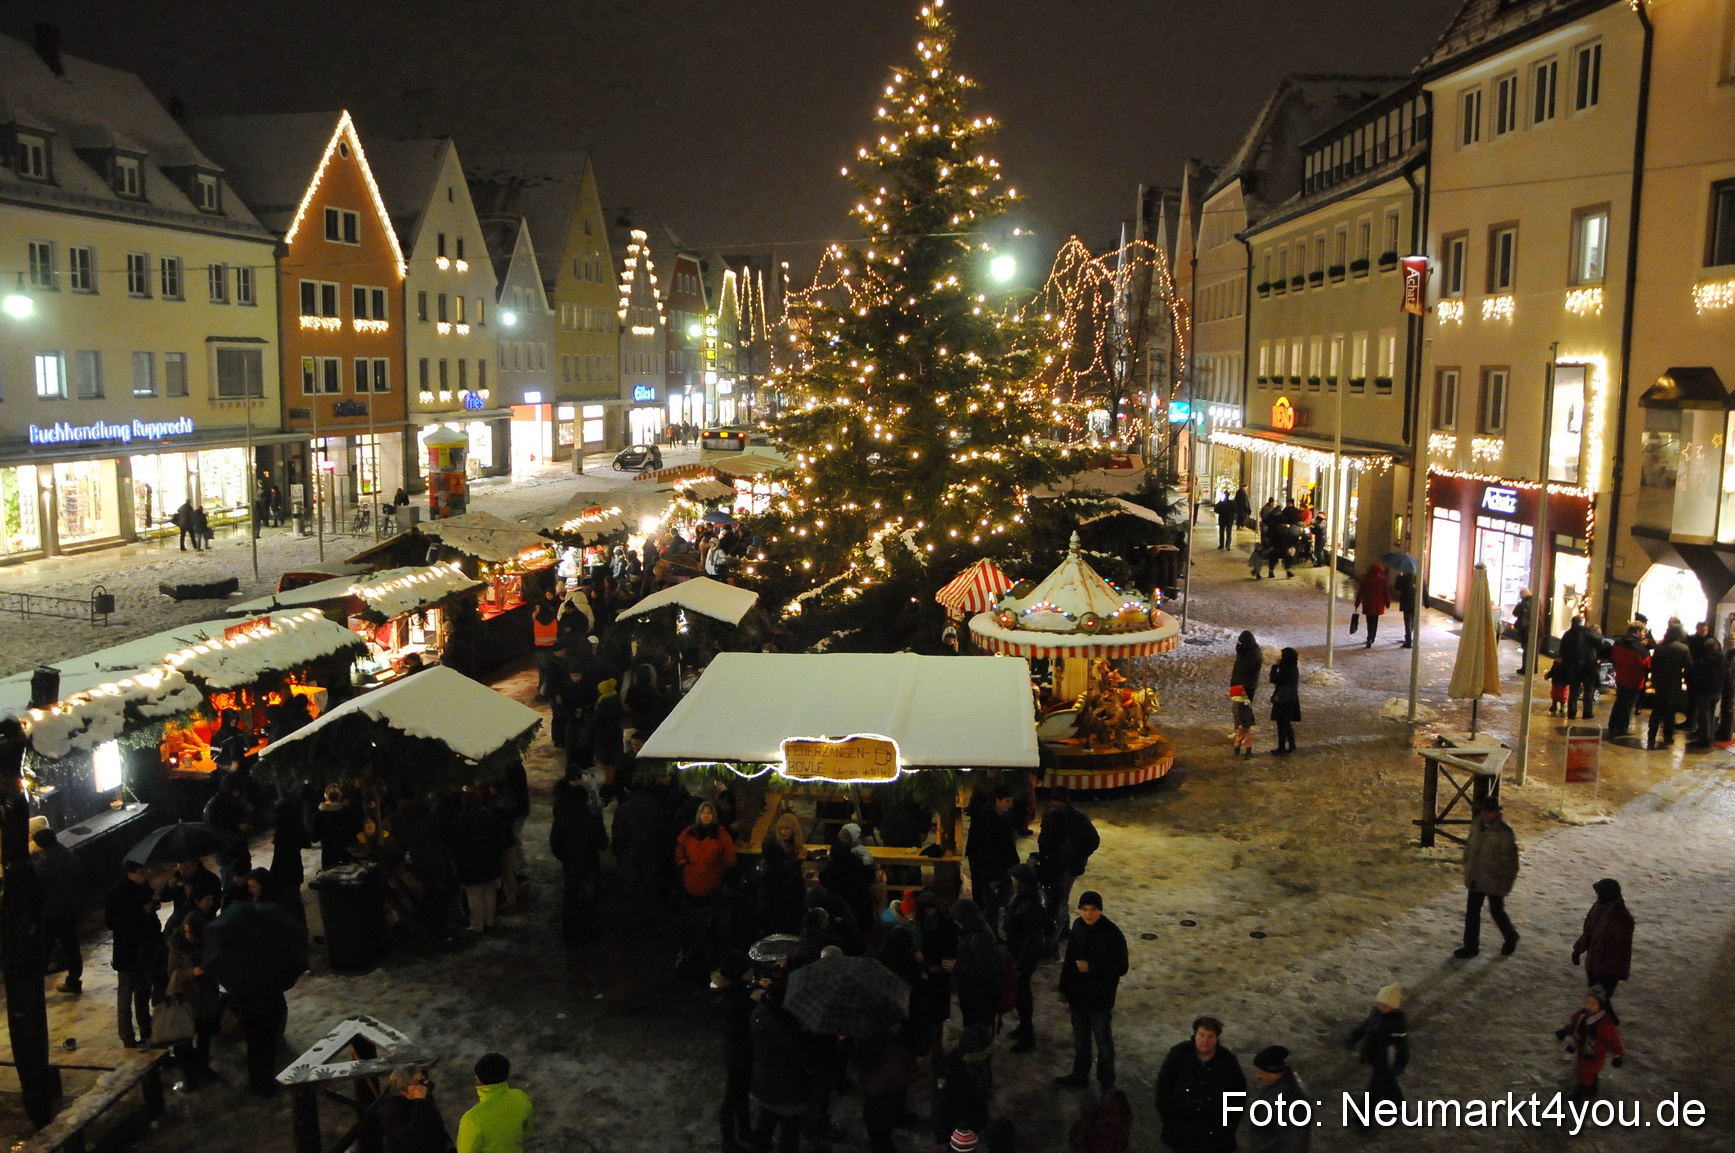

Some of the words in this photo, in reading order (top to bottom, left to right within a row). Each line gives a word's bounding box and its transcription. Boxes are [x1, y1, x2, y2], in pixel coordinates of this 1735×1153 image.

[705, 315, 718, 371] HOTEL
[29, 420, 131, 444] Buchhandlung
[132, 416, 193, 440] Rupprecht
[1272, 404, 1294, 430] RENO
[1482, 486, 1518, 513] Achatz
[786, 745, 870, 759] FEUERZANGEN-
[788, 761, 825, 774] BOWLE
